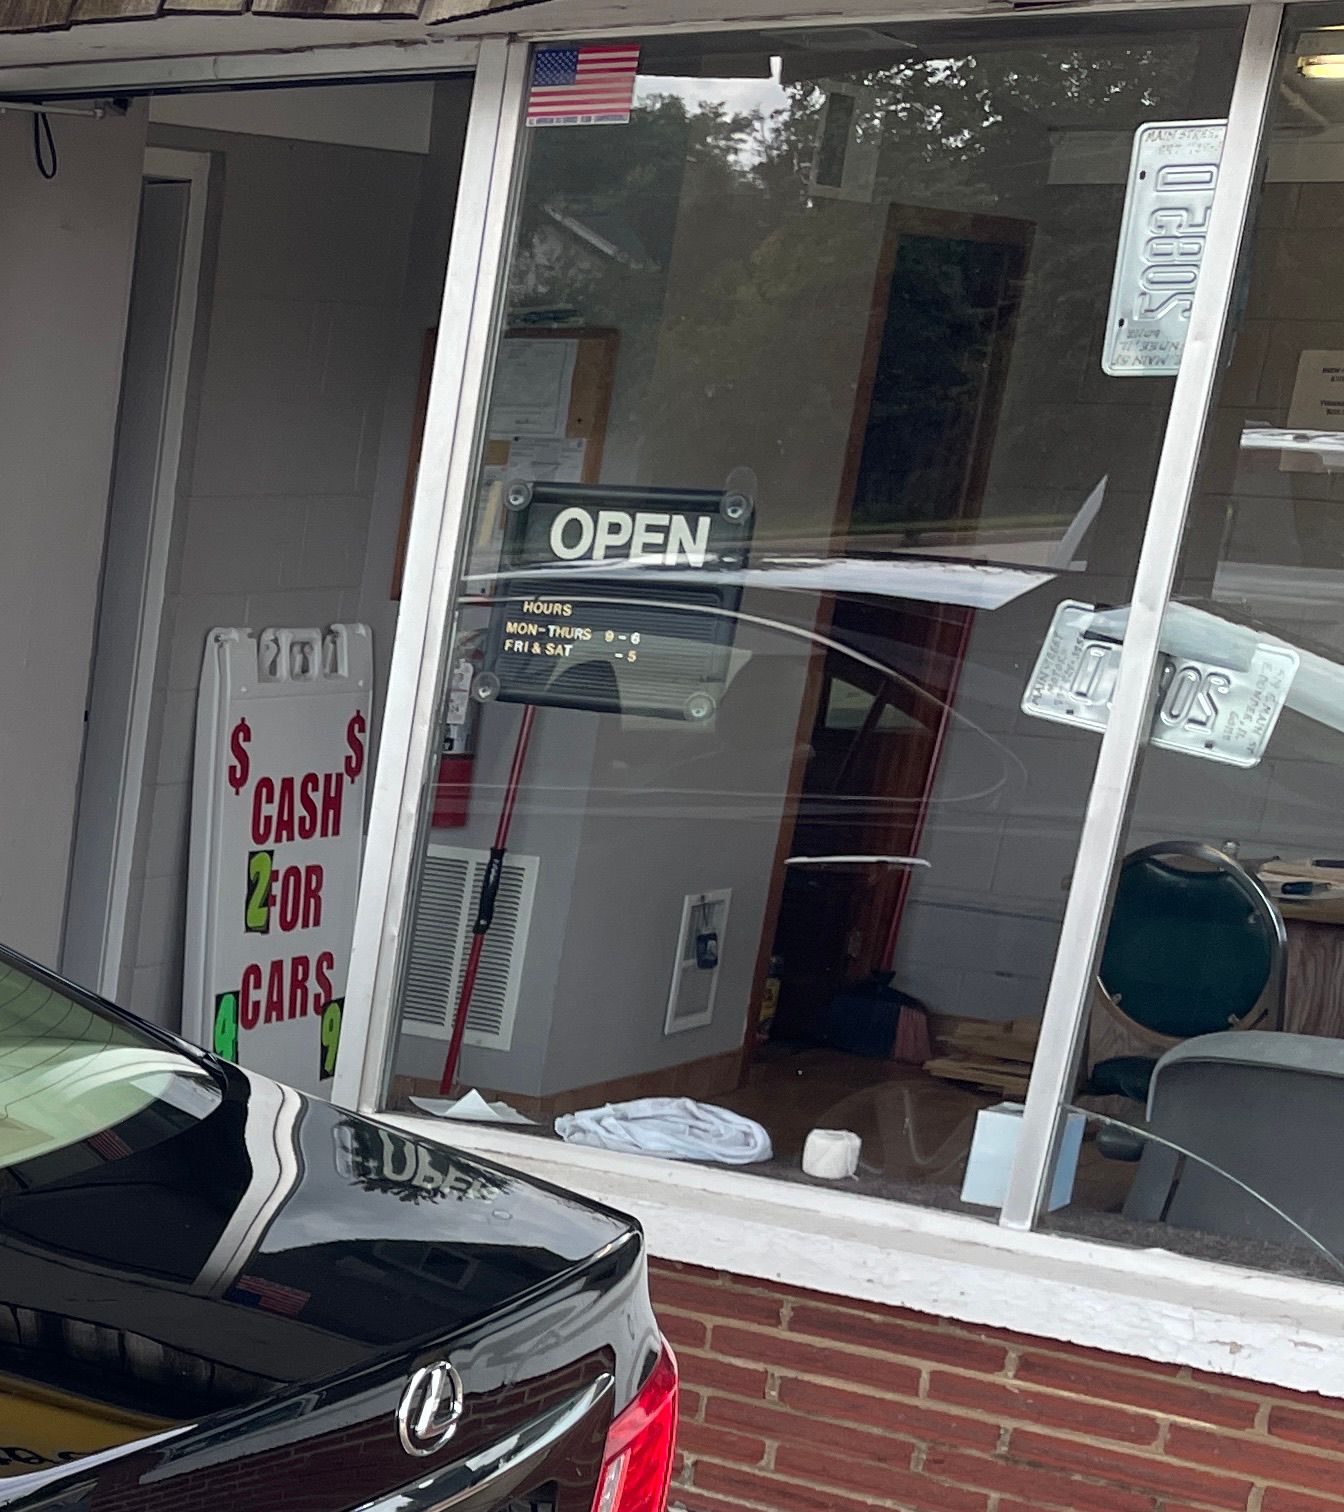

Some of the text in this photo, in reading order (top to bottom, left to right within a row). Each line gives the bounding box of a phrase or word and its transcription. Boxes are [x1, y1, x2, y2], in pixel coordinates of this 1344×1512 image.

[550, 507, 711, 568] OPEN
[523, 600, 573, 617] HOURS
[504, 639, 529, 653] FRI
[531, 642, 541, 655] &
[545, 642, 573, 657] SAT
[627, 650, 637, 662] 5
[228, 716, 252, 796] $
[344, 709, 366, 784] $
[251, 772, 344, 846] CASH
[248, 851, 272, 929] 2
[267, 864, 323, 932] FOR
[240, 951, 334, 1030] CARS
[214, 993, 238, 1061] 4
[321, 1001, 342, 1073] 9
